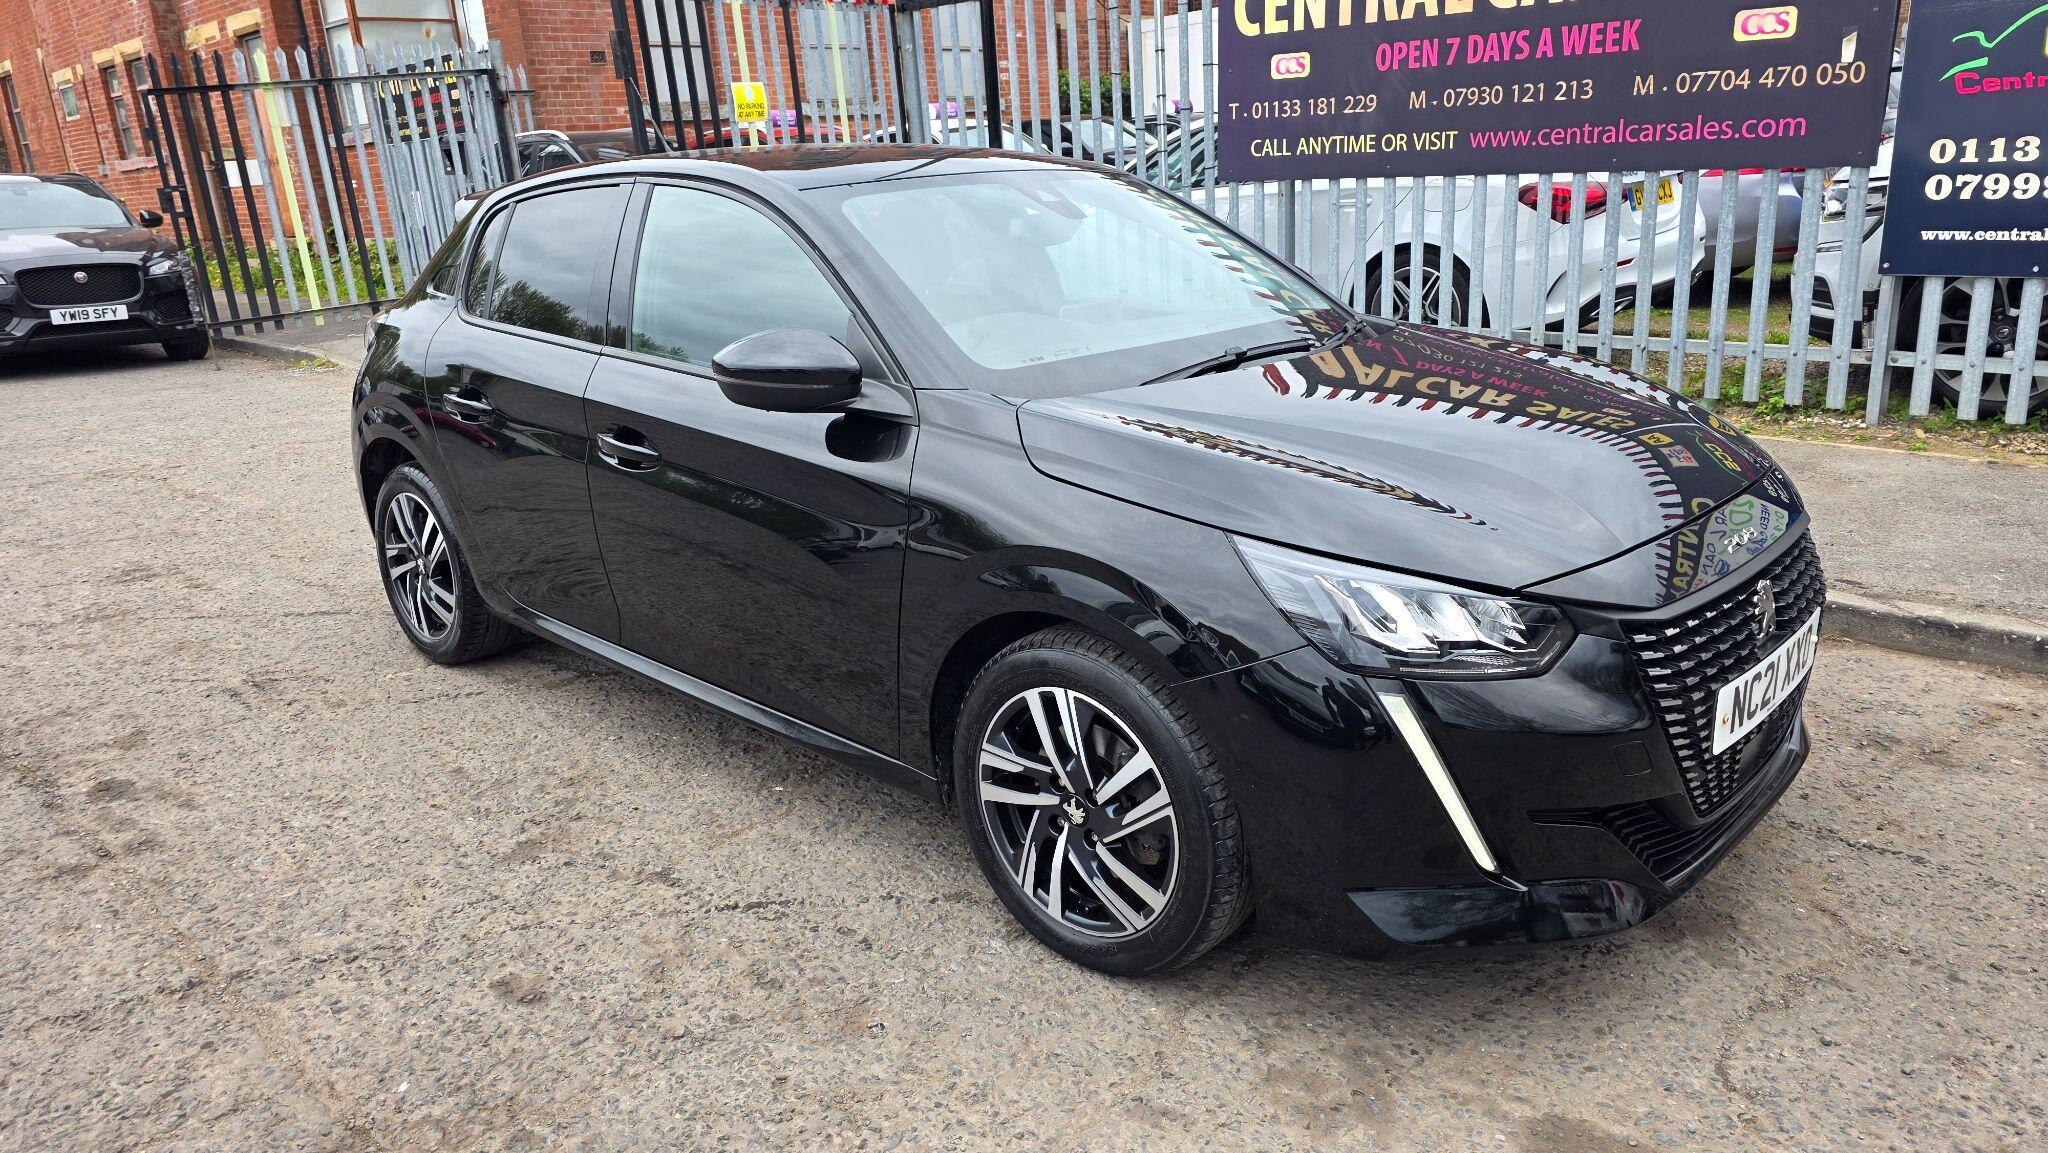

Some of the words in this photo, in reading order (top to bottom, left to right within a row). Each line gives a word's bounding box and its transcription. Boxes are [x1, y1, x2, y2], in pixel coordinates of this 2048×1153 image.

[1740, 10, 1791, 36] CCS
[1376, 38, 1439, 71] OPEN
[1446, 37, 1461, 66] 7
[1467, 30, 1531, 65] DAYS
[1535, 28, 1553, 59] A
[1562, 18, 1642, 55] WEEK
[1275, 56, 1306, 76] CCS
[1676, 67, 1752, 94] 07704
[1759, 64, 1807, 89] 470
[1816, 61, 1866, 86] 050
[1252, 99, 1301, 119] 01133
[1308, 97, 1336, 115] 181
[1342, 94, 1377, 114] 229
[1443, 86, 1504, 108] 07930
[1511, 82, 1545, 104] 121
[1555, 79, 1593, 101] 213
[1251, 138, 1292, 157] CALL
[1297, 134, 1376, 155] ANYTIME
[1382, 133, 1408, 152] OR
[1413, 130, 1458, 151] VISIT
[1470, 114, 1807, 148] www.centralcarsales.com
[1929, 135, 2041, 164] 0113
[1924, 172, 2048, 201] 0799
[60, 309, 90, 322] YW19
[93, 307, 118, 319] SFY
[1724, 527, 1757, 554] 208
[1730, 654, 1781, 735] NC21
